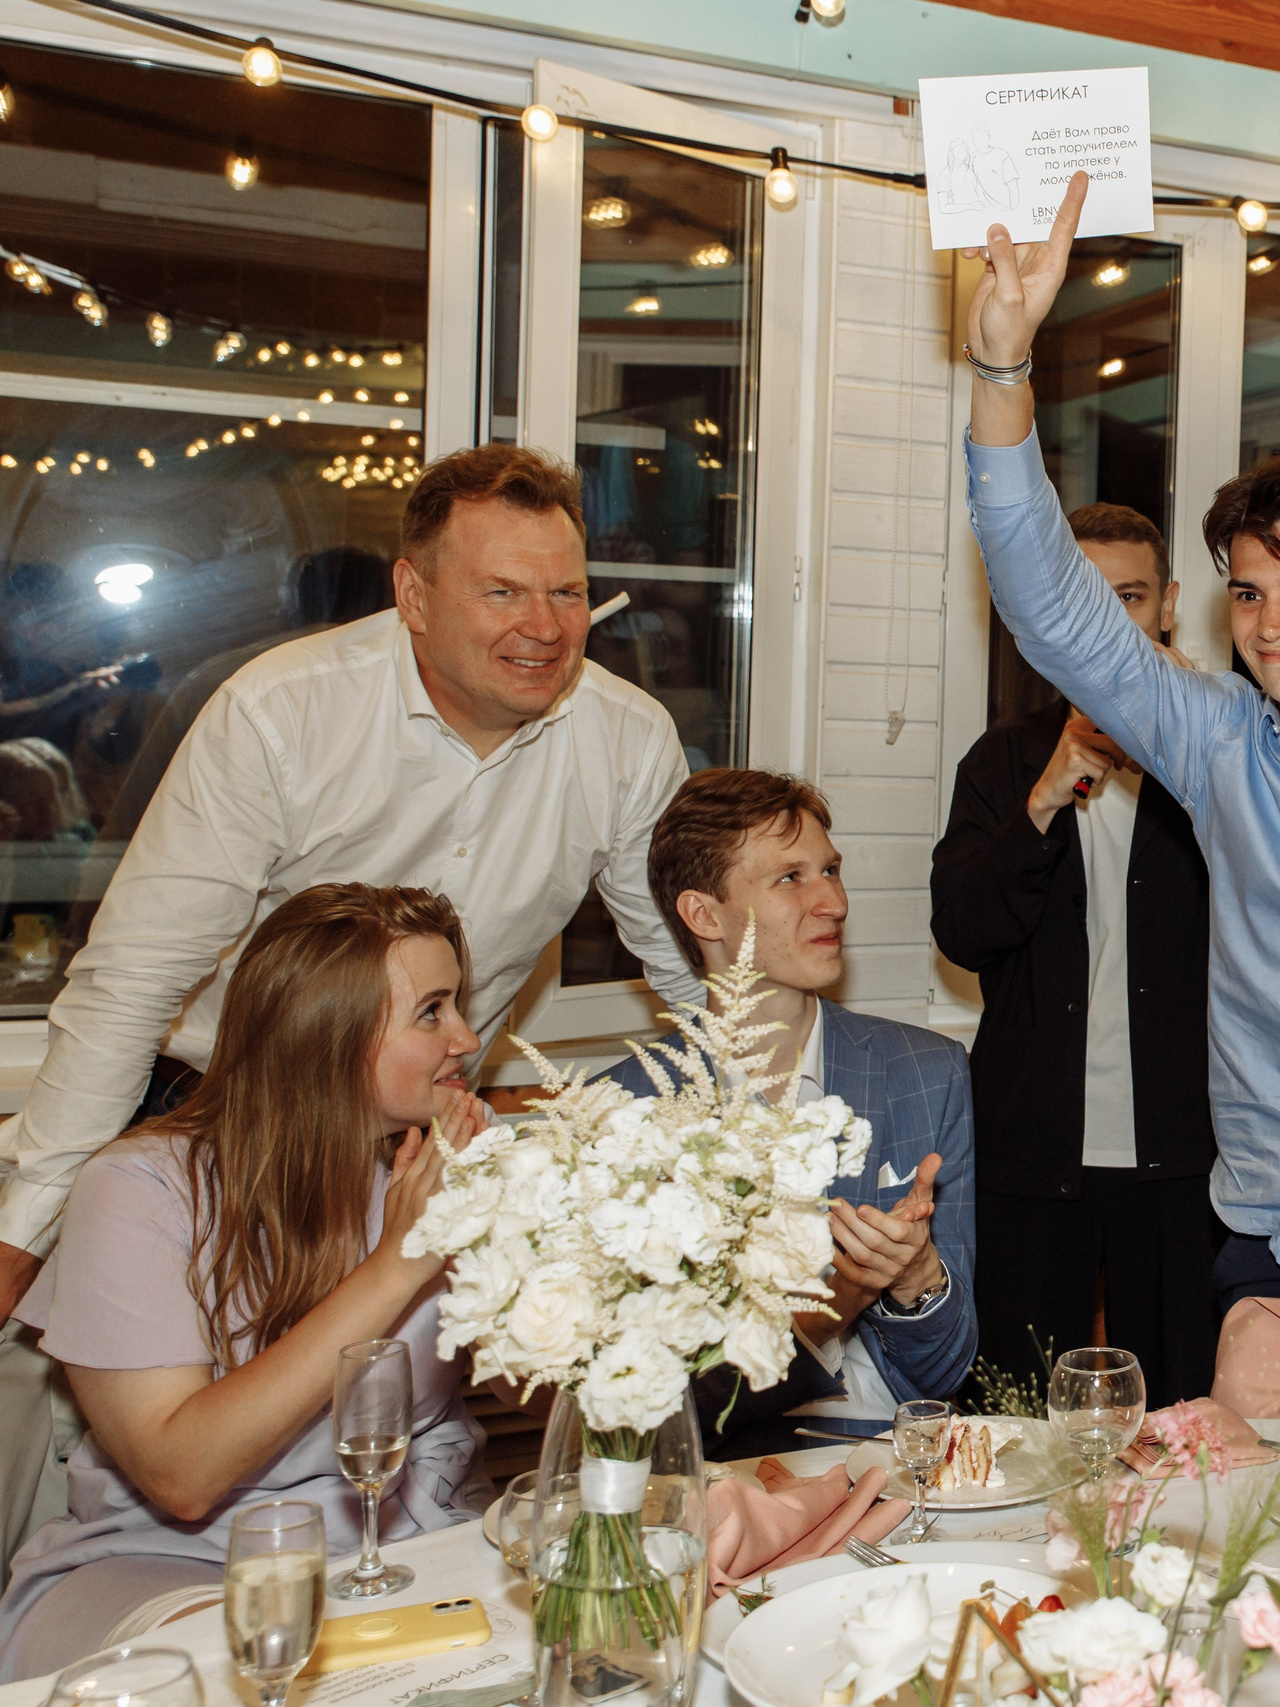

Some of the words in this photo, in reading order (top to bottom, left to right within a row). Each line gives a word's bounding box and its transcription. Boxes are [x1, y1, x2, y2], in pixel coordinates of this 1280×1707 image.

[985, 85, 1089, 105] СЕРТИФИКАТ
[1031, 128, 1062, 142] Даёт
[1065, 126, 1090, 138] Вам
[1093, 124, 1130, 138] право
[1025, 145, 1057, 157] стать
[1059, 139, 1138, 156] поручителем
[1045, 161, 1060, 170] по
[1063, 157, 1111, 168] ипотеке
[1113, 156, 1121, 166] у
[1039, 172, 1127, 186] моложёнов.
[389, 1653, 510, 1705] СЕРТИФИКАТ
